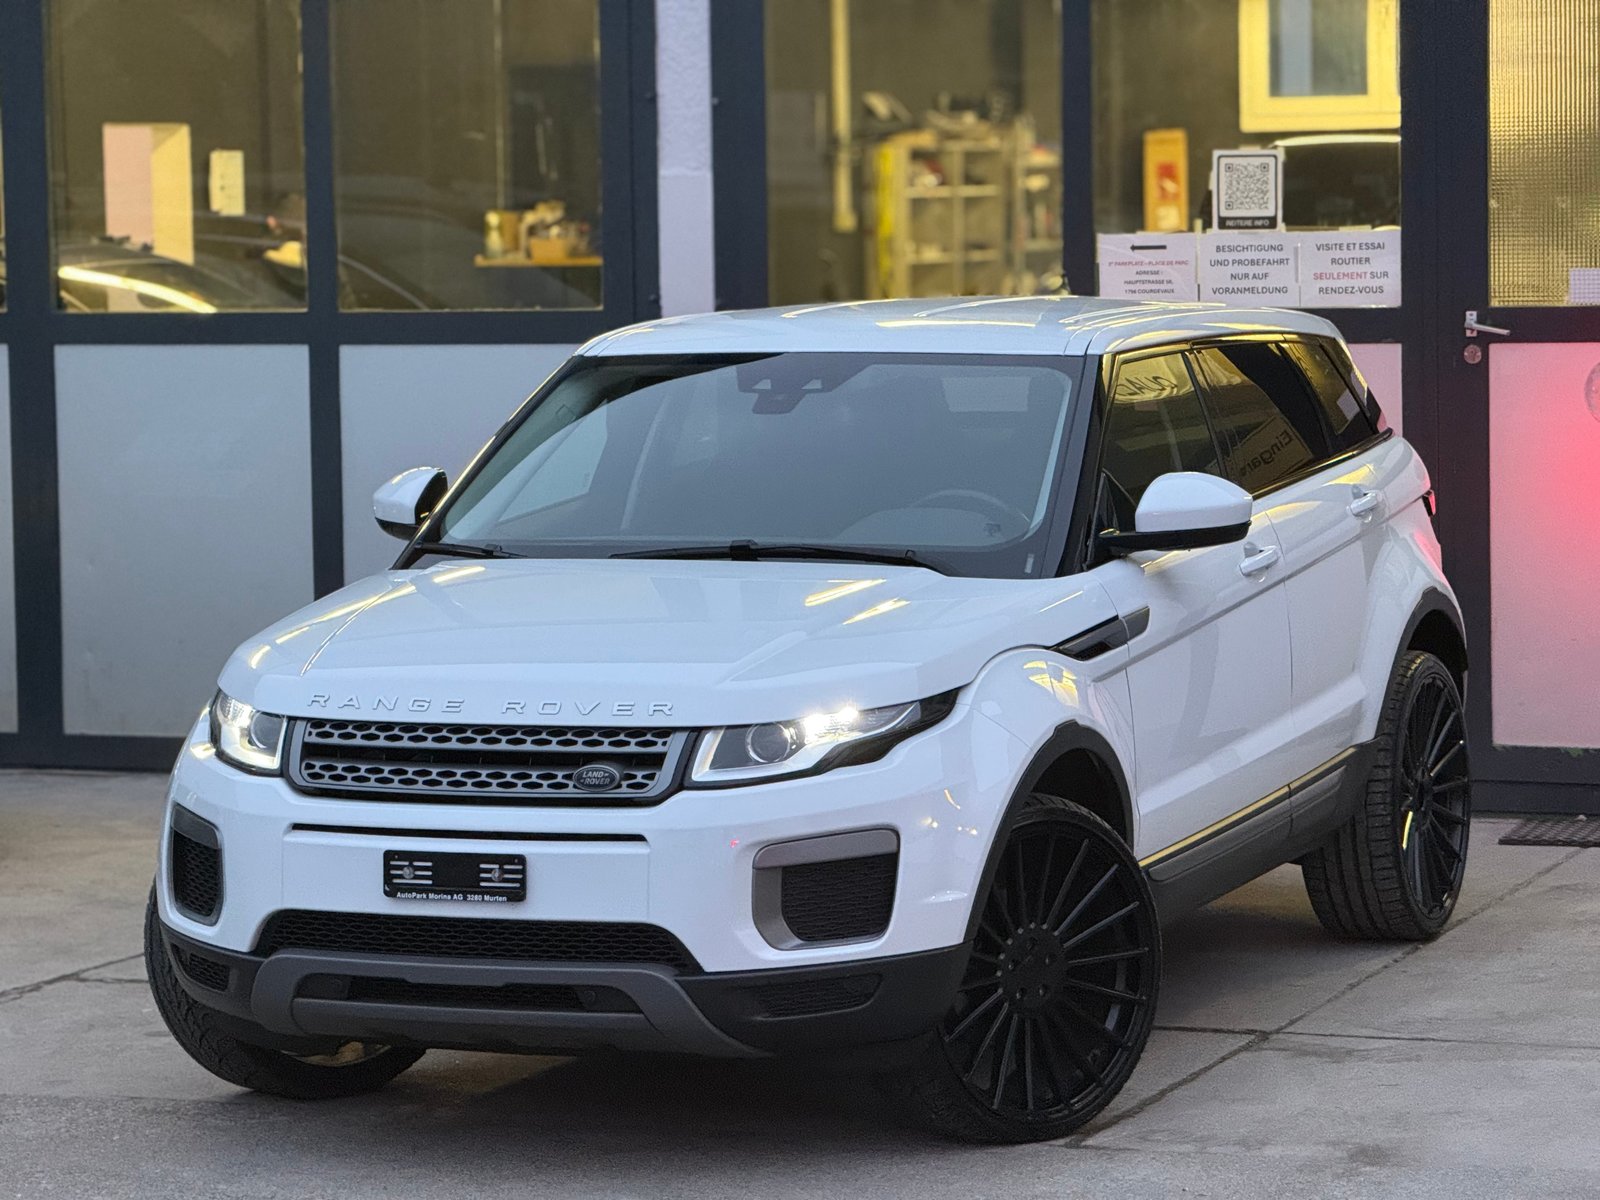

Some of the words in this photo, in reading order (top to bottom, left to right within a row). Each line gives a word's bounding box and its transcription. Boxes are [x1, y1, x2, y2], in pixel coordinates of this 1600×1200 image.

[1215, 244, 1284, 253] BESICHTIGUNG
[1315, 243, 1344, 252] VISITE
[1346, 243, 1357, 251] ET
[1358, 242, 1385, 251] ESSAI
[1209, 259, 1230, 267] UND
[1231, 258, 1290, 267] PROBEFAHRT
[1330, 257, 1371, 266] ROUTIER
[1230, 272, 1250, 280] NUR
[1251, 272, 1270, 280] AUF
[1313, 272, 1368, 280] SEULEMENT
[1369, 271, 1389, 279] SUR
[1212, 286, 1288, 295] VORANMELDUNG
[1318, 286, 1384, 295] RENDEZ-VOUS
[307, 694, 465, 714] RANGE
[501, 700, 674, 717] ROVER
[396, 892, 427, 900] AutoPark
